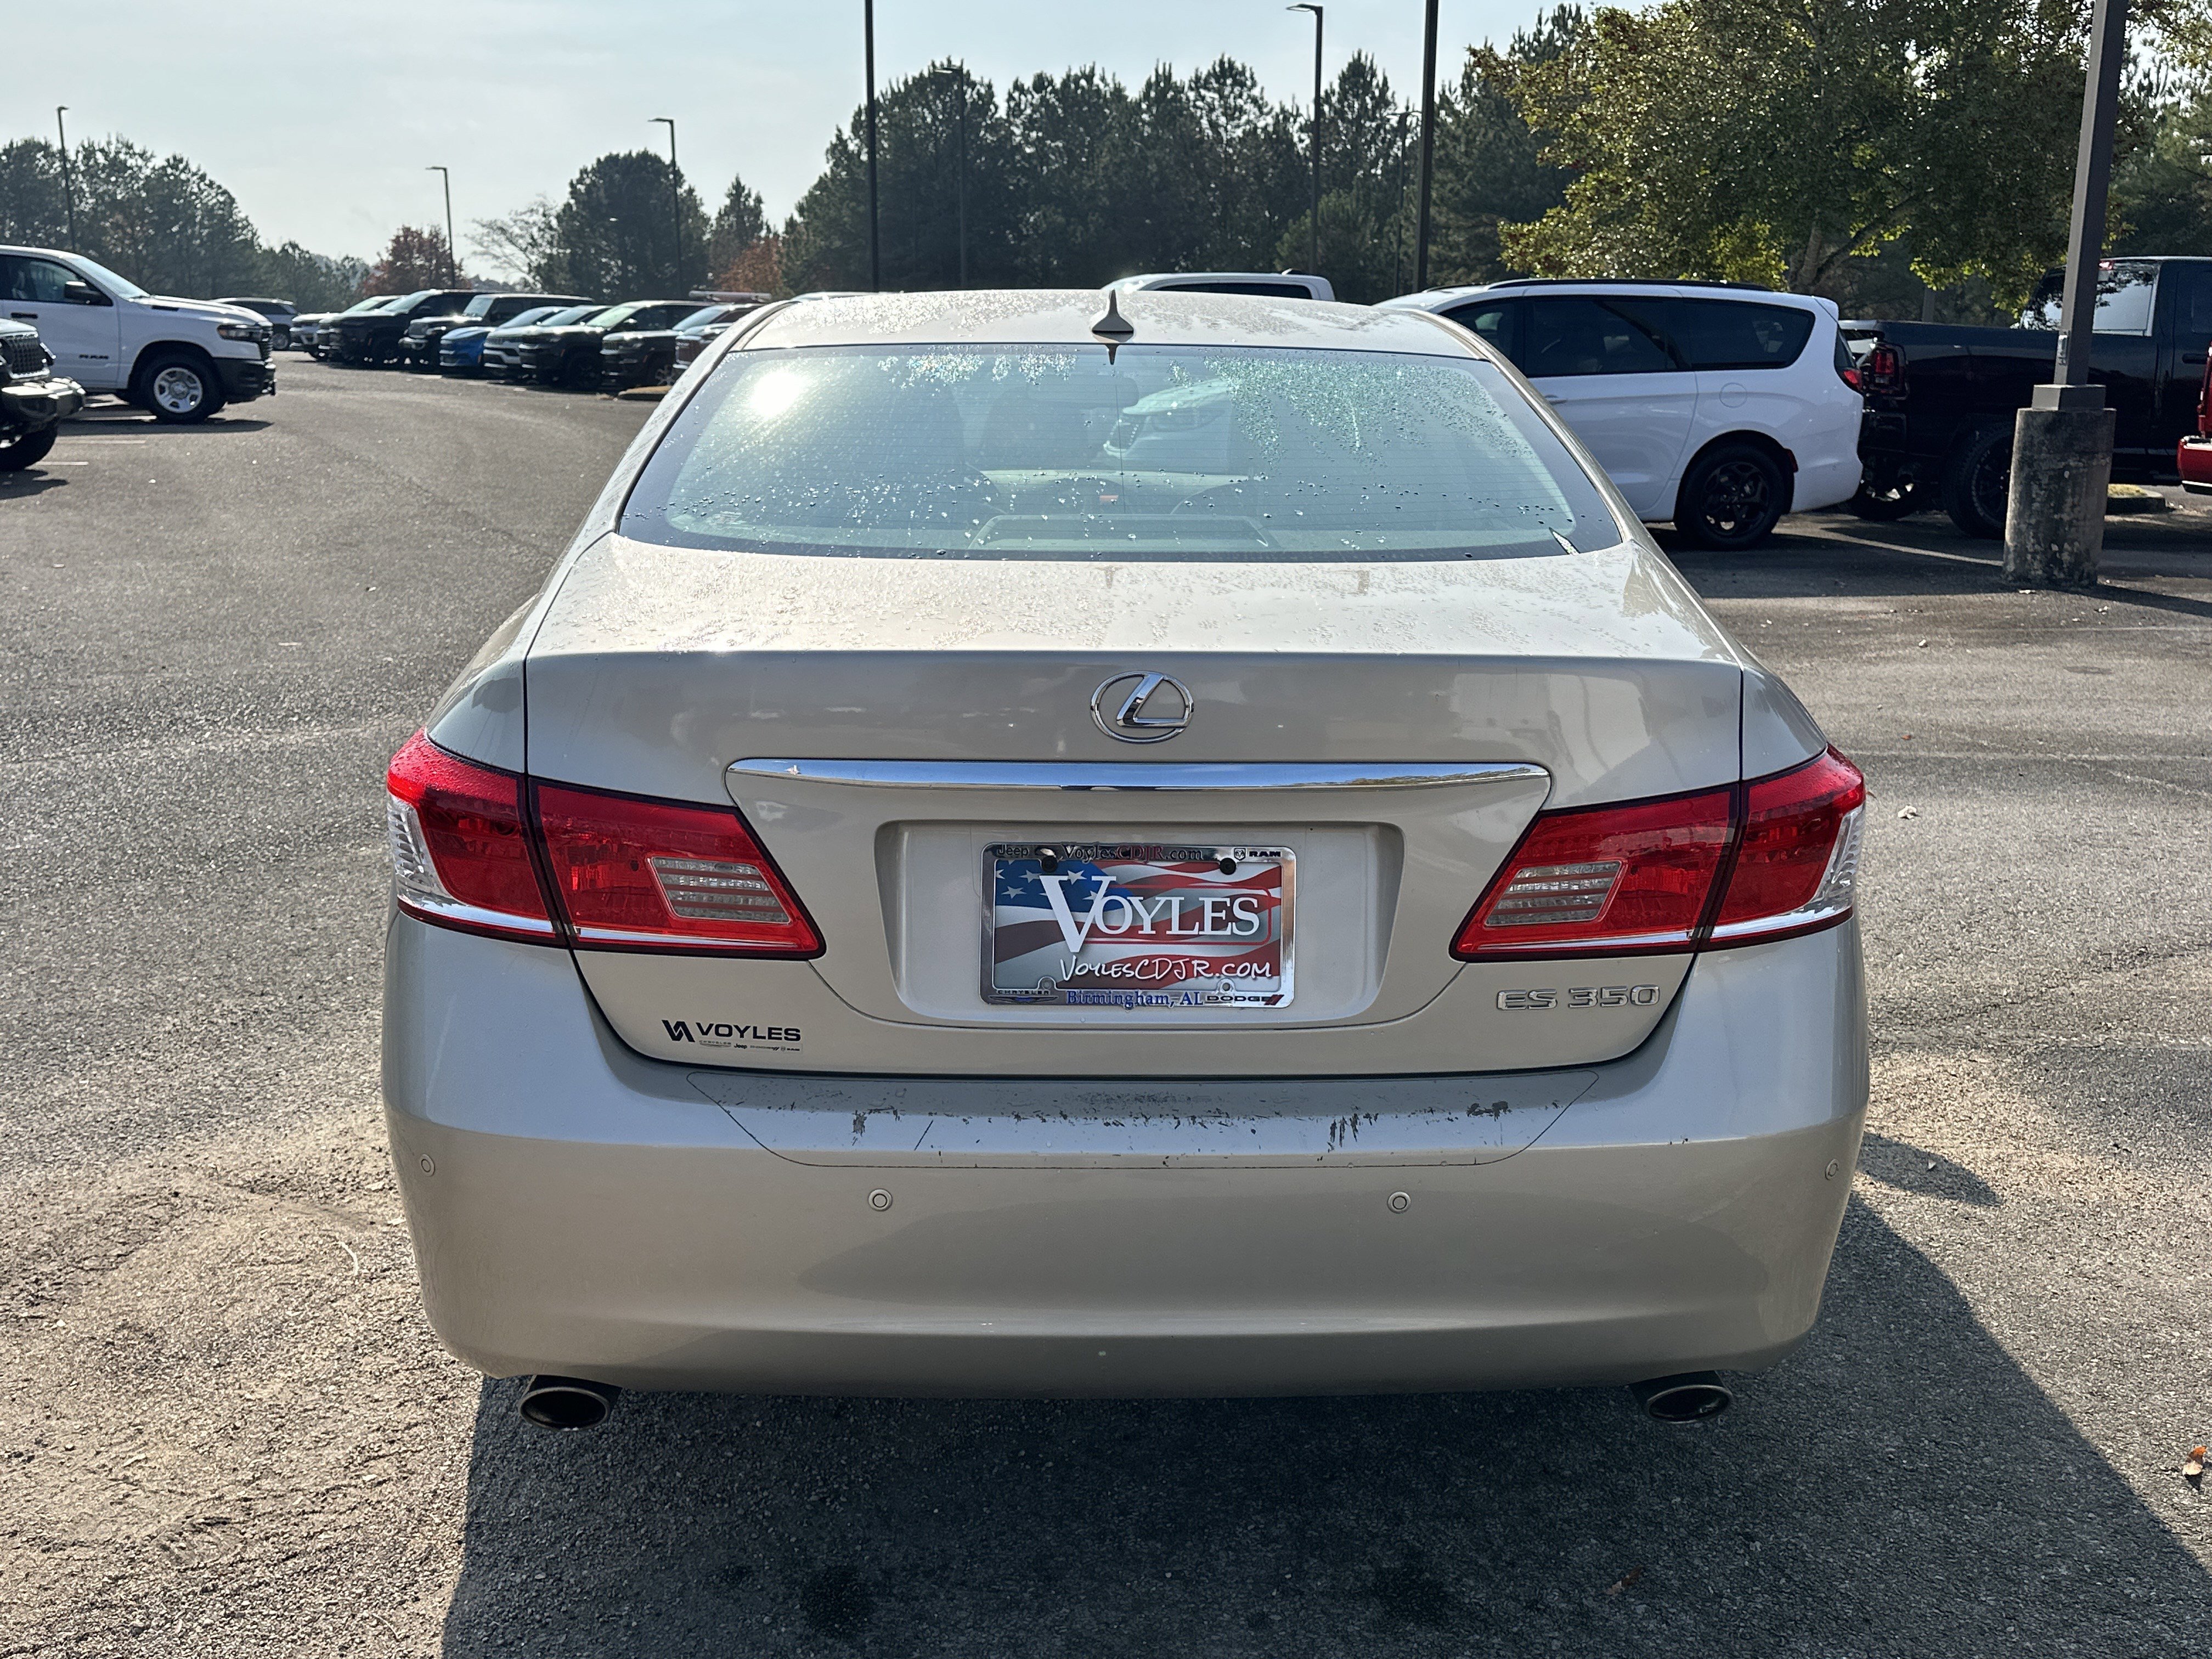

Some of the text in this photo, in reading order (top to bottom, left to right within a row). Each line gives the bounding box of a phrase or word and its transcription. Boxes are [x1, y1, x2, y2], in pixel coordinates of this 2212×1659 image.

[997, 844, 1029, 857] Jeep
[1062, 843, 1204, 864] VoylesCDJR.com
[1066, 990, 1204, 1009] Birmingham, AL
[1497, 985, 1660, 1011] ES 350
[696, 1023, 802, 1041] VOYLES
